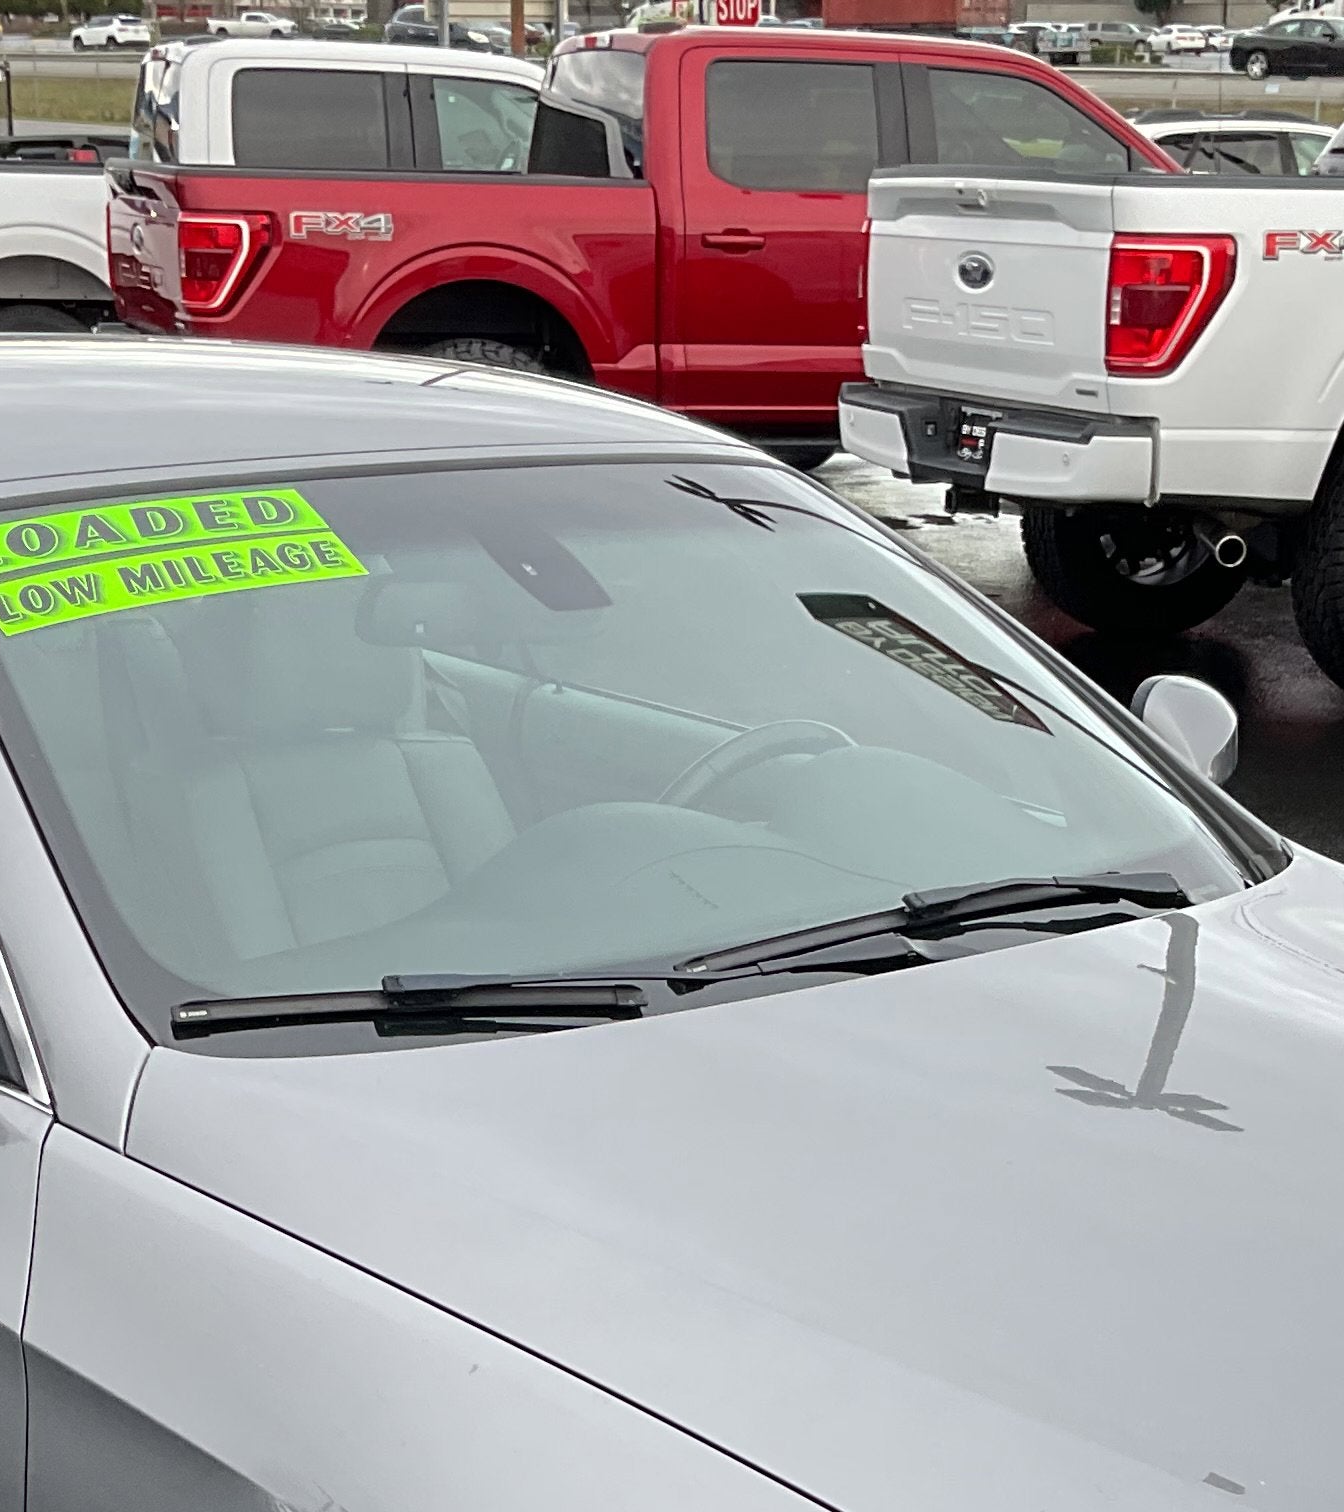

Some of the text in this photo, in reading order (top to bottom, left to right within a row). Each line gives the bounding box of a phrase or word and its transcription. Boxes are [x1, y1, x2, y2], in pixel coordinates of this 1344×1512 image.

[718, 0, 758, 21] STOP
[289, 211, 394, 239] FX4
[902, 297, 1056, 346] F-150
[116, 540, 347, 596] MILEAGE
